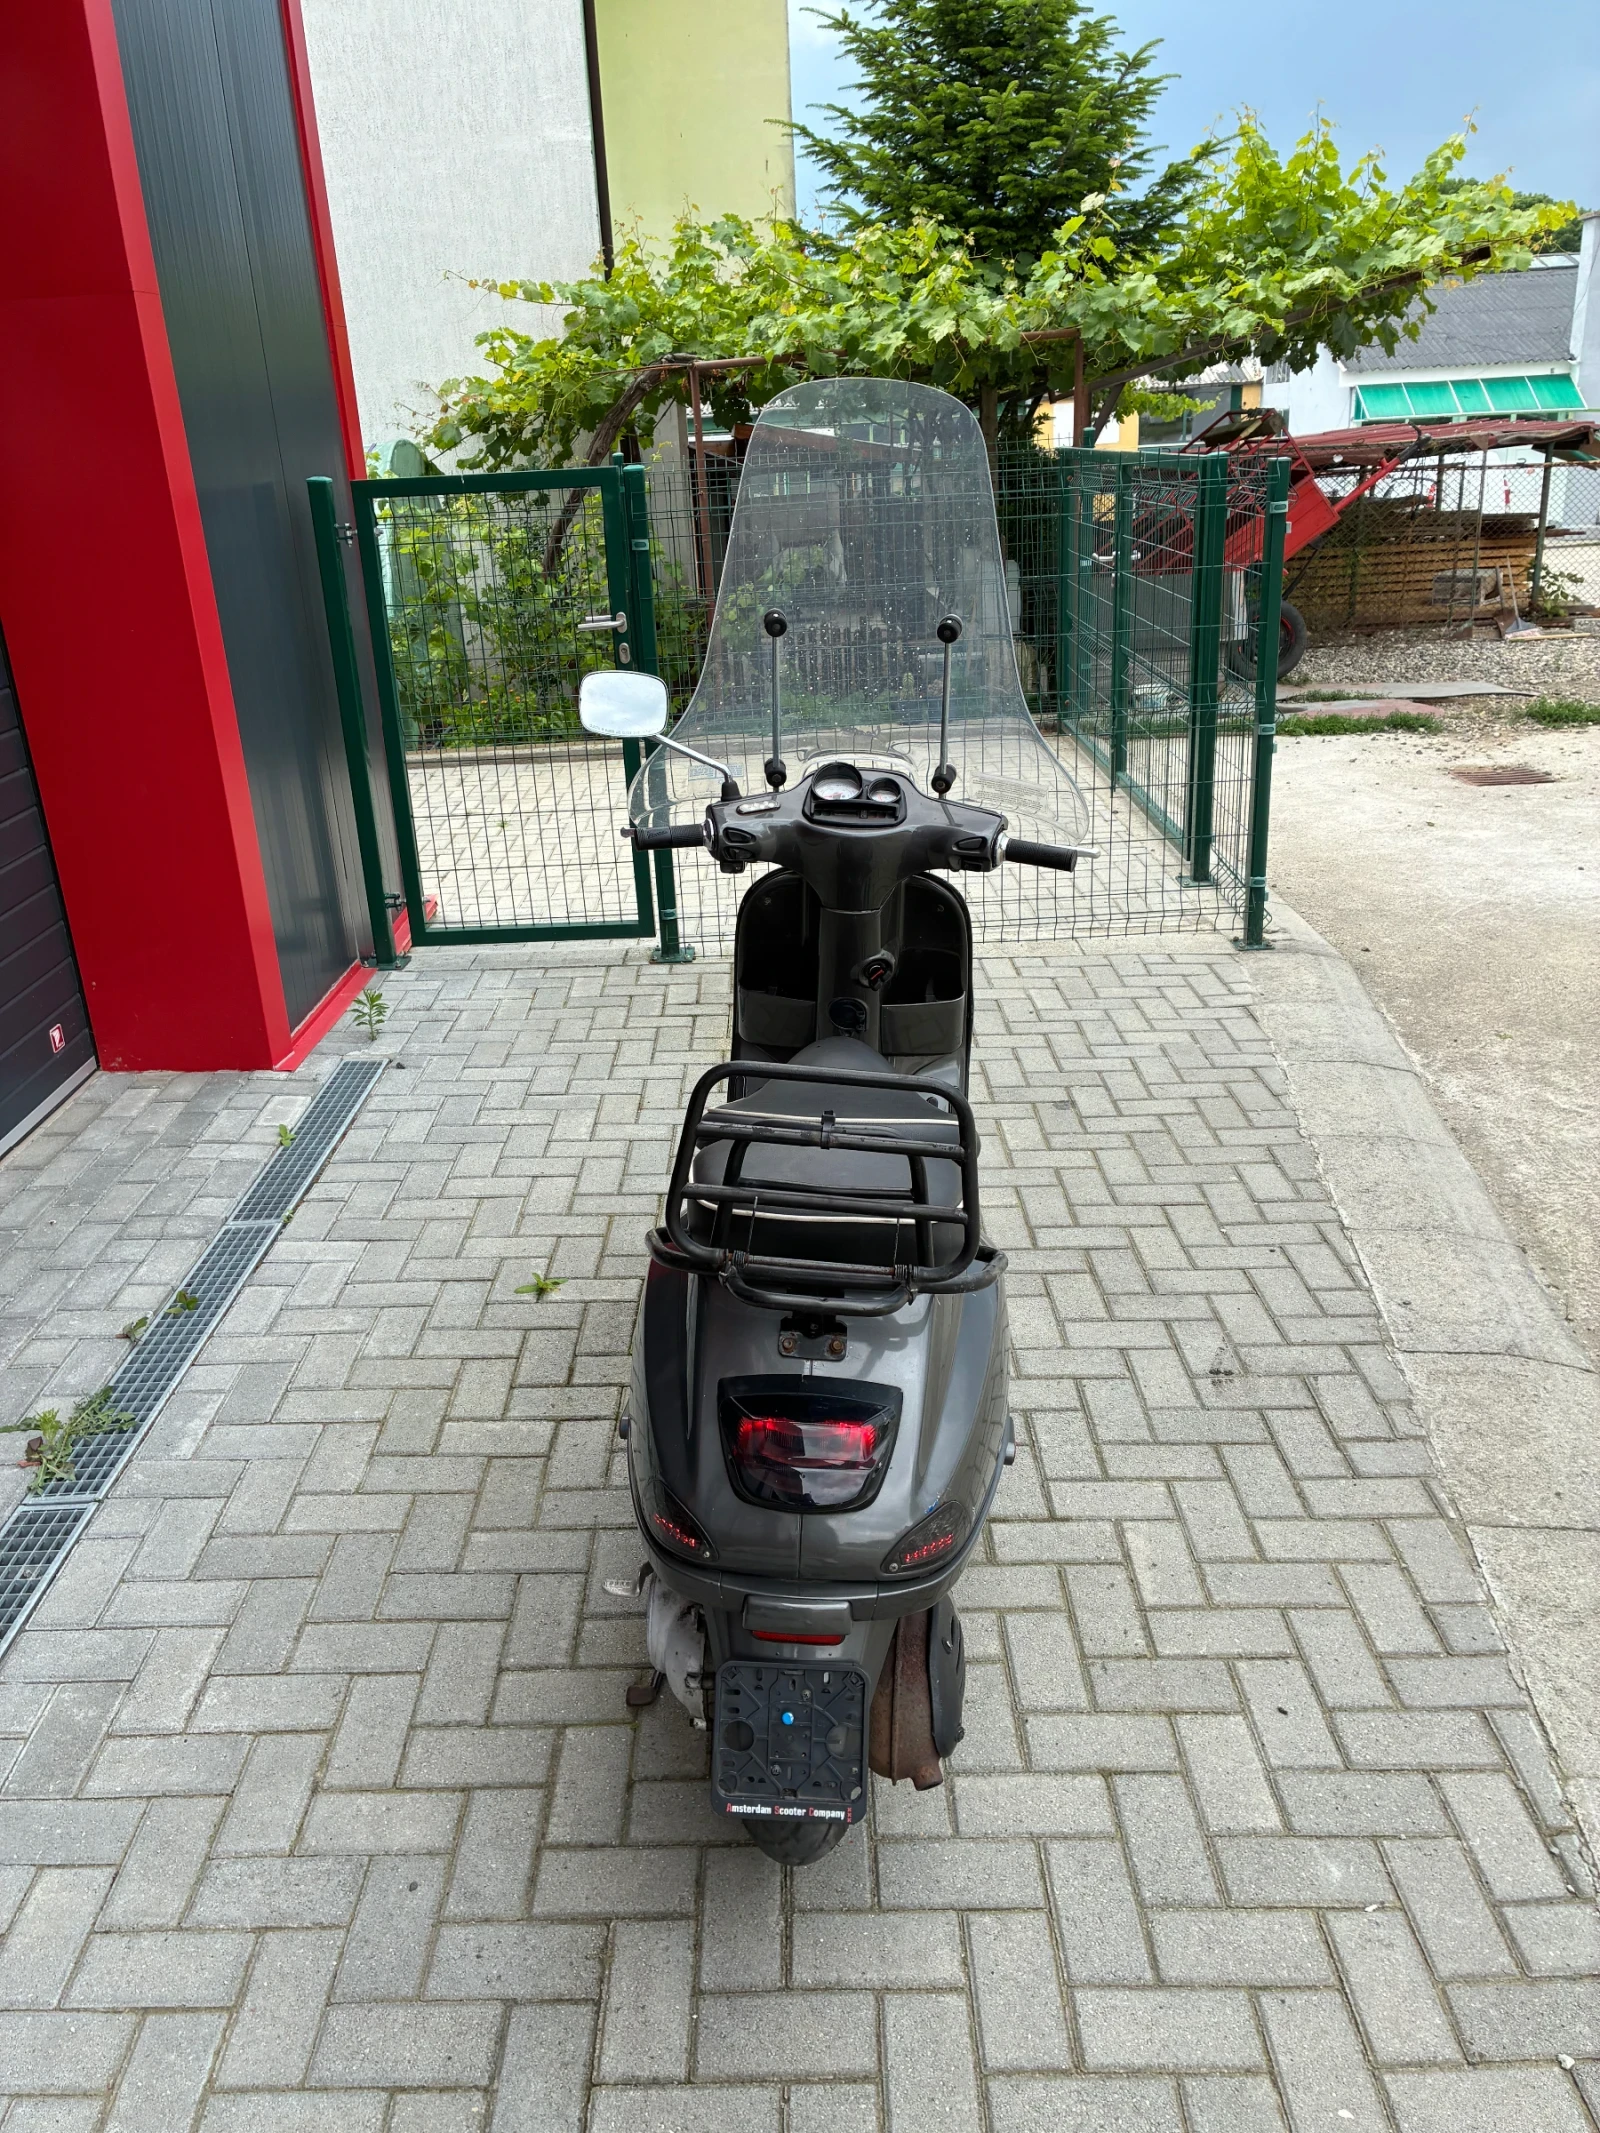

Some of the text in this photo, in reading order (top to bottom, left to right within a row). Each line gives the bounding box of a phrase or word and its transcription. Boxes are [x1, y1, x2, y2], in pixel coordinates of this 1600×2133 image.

[726, 1803, 845, 1820] Amsterdam Scooter Company
